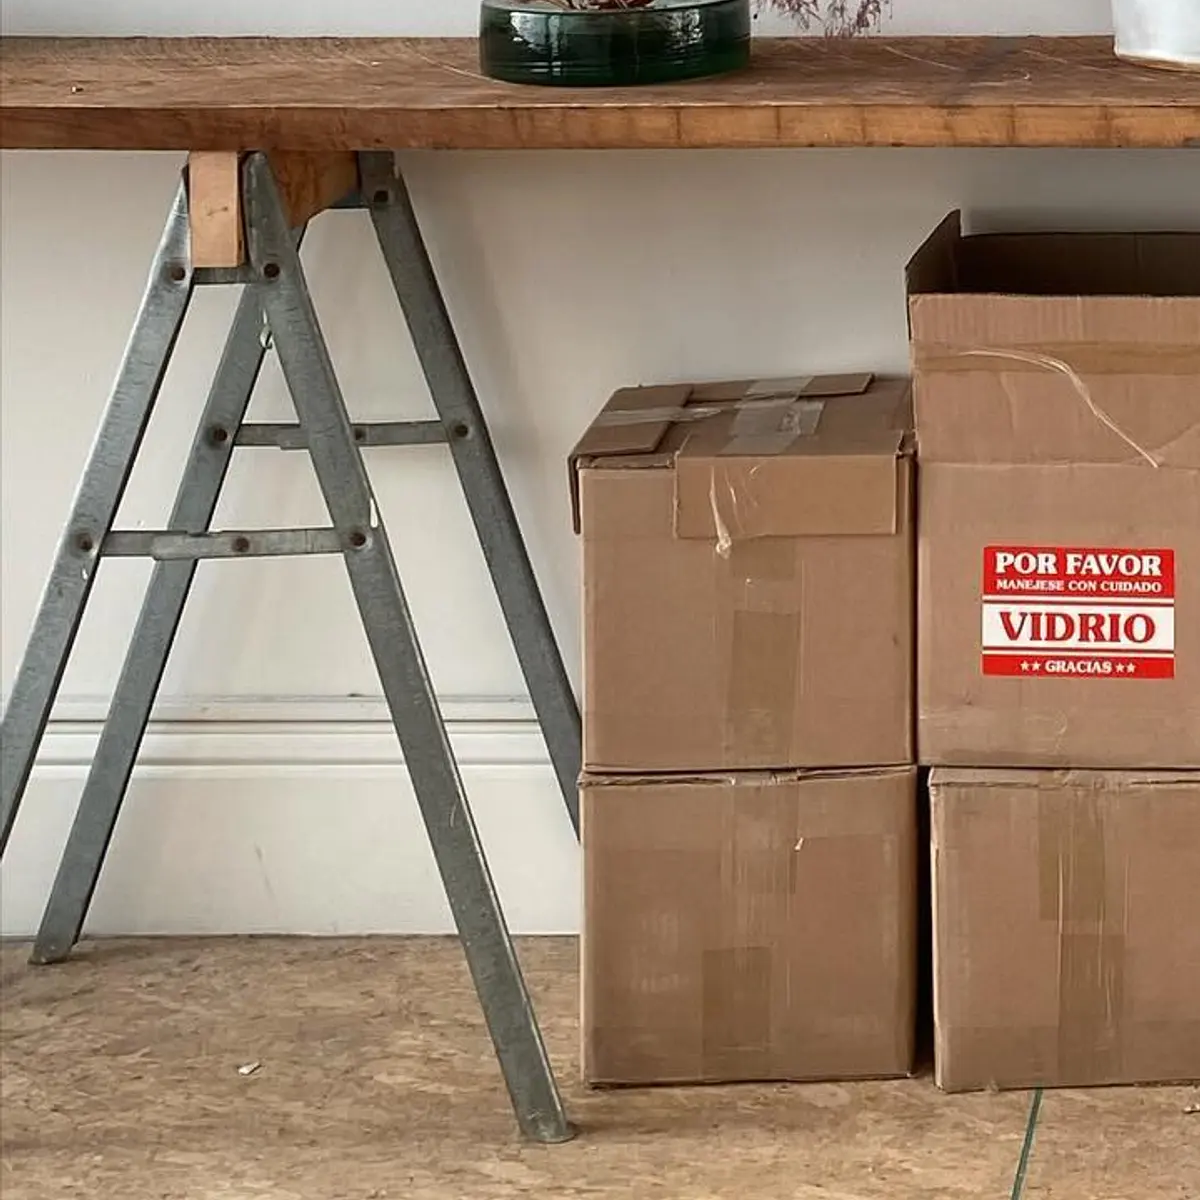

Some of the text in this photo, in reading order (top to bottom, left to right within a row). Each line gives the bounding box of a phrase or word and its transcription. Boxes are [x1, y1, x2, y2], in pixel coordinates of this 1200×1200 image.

[995, 552, 1162, 576] POR FAVOR
[996, 578, 1162, 593] MANEJESE CON CUIDADO
[999, 611, 1156, 644] VIDRIO
[1045, 659, 1112, 674] GRACIAS
